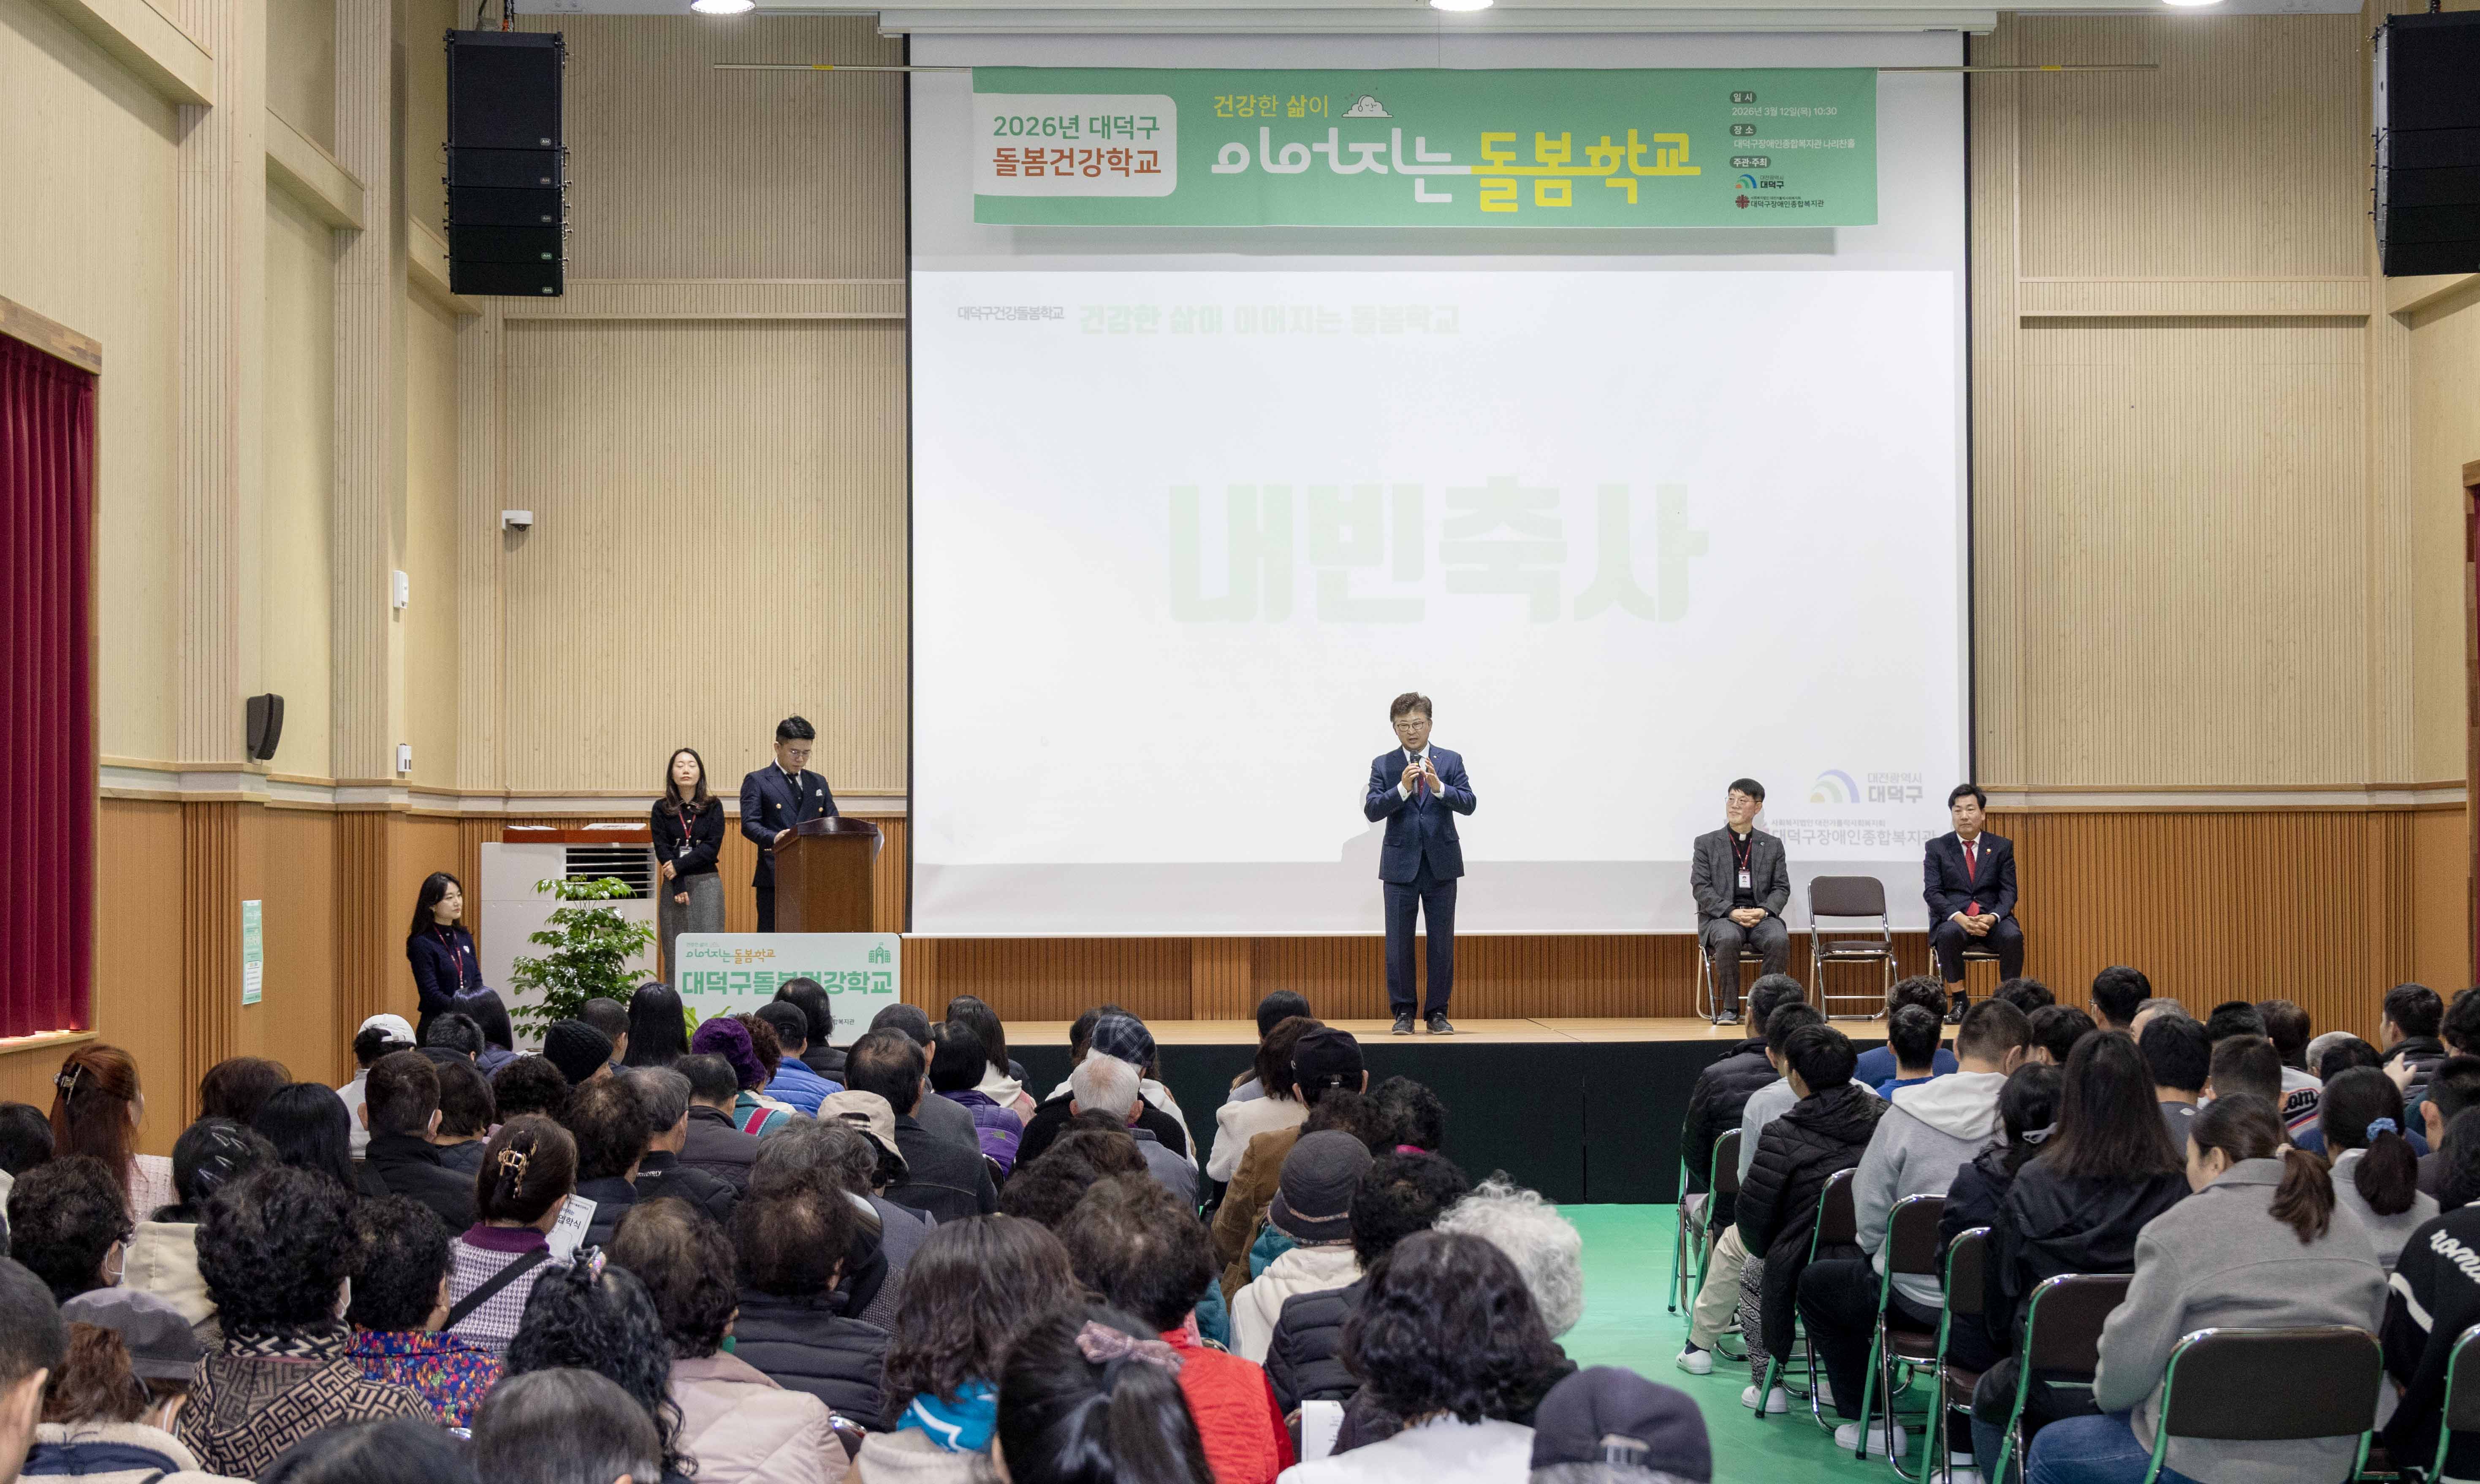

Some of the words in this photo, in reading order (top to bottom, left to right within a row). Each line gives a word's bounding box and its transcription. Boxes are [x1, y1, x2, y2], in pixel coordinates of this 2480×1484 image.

[1213, 95, 1279, 119] 건강한
[1286, 95, 1328, 119] 삶이
[1732, 107, 1762, 116] 2026년
[1765, 107, 1777, 116] 3월
[1780, 107, 1811, 117] 12일(목)
[1815, 107, 1837, 115] 10:30
[993, 114, 1080, 140] 2026년
[1089, 116, 1160, 140] 대덕구
[1734, 139, 1821, 149] 대덕구장애인종합복지관
[993, 148, 1161, 177] 돌봄건강학교
[1211, 126, 1471, 203] 이어지는
[1472, 128, 1701, 212] 돌봄학교
[1760, 181, 1784, 189] 대덕구
[1751, 200, 1824, 208] 대덕구장애인종합복지관
[1079, 305, 1161, 335] 건강한
[1169, 305, 1224, 335] 삶이
[1233, 305, 1343, 335] 이어지는
[1351, 305, 1460, 335] 돌봄학교
[1169, 475, 1709, 624] 내빈축사
[1867, 772, 1922, 784] 대전광역시
[1868, 785, 1923, 804] 대덕구
[686, 948, 730, 963] 이어지는
[735, 948, 776, 964] 돌봄학교
[558, 1215, 581, 1229] 입학식
